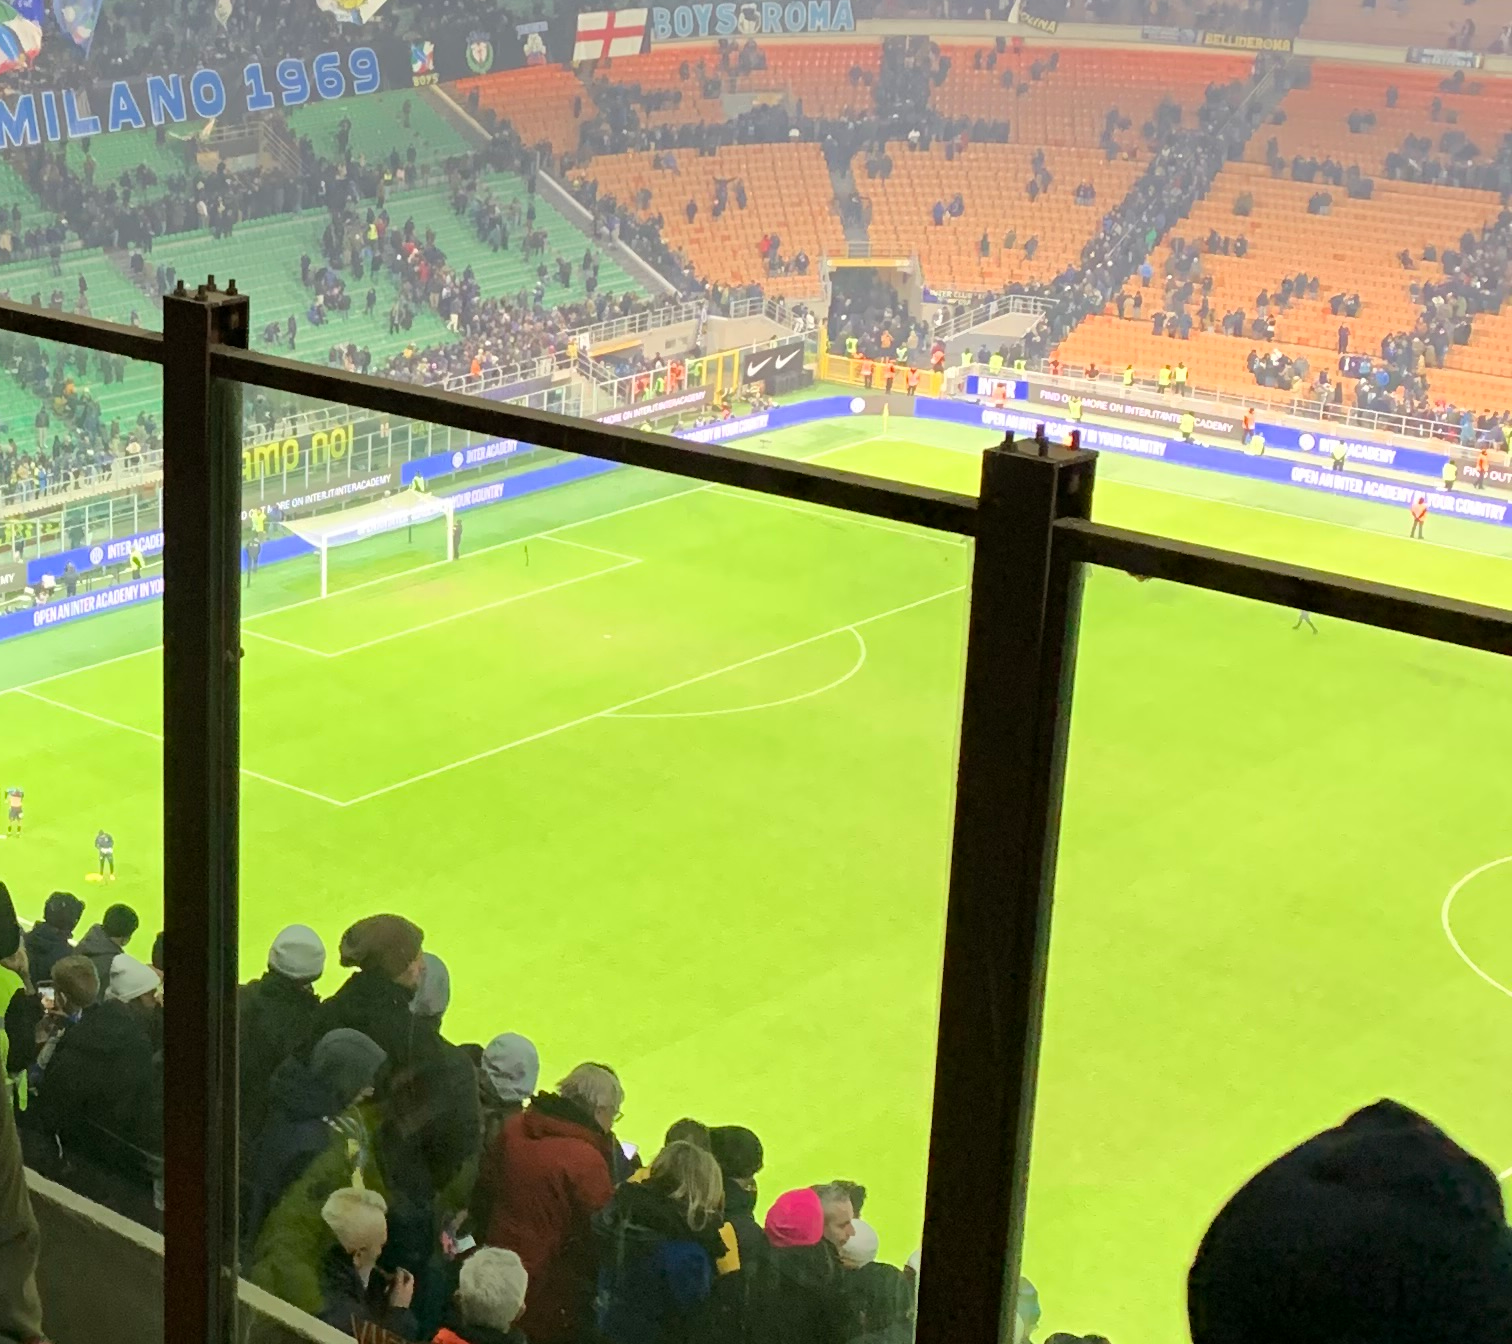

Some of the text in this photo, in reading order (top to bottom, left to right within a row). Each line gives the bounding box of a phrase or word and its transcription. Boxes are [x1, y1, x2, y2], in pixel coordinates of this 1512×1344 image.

[652, 0, 855, 39] BOYS ROMA
[244, 46, 381, 113] 1969
[978, 377, 1016, 399] INTR
[1039, 389, 1061, 402] FIND
[1082, 397, 1108, 411] MORE
[1109, 402, 1123, 413] ON
[982, 410, 1005, 427] OPEN
[1098, 430, 1123, 449] YOUR
[1123, 435, 1167, 457] COUNTRY
[466, 439, 519, 464] INTER ACADEMY
[1347, 443, 1397, 464] ACADEMY
[1463, 465, 1512, 484] FIN OUT
[291, 497, 304, 508] ON
[471, 483, 505, 505] COUNTRY
[1291, 466, 1319, 485] OPEN
[1318, 472, 1334, 488] AN
[1334, 474, 1364, 494] INTER
[1364, 481, 1414, 503] ACADEMY
[1427, 492, 1455, 512] YOUR
[1455, 498, 1507, 521] COUNTRY
[107, 540, 131, 560] INTER
[33, 609, 56, 627] OPEN
[56, 605, 70, 622] AN
[70, 598, 95, 619] INTER
[95, 584, 138, 612] ACADEMY
